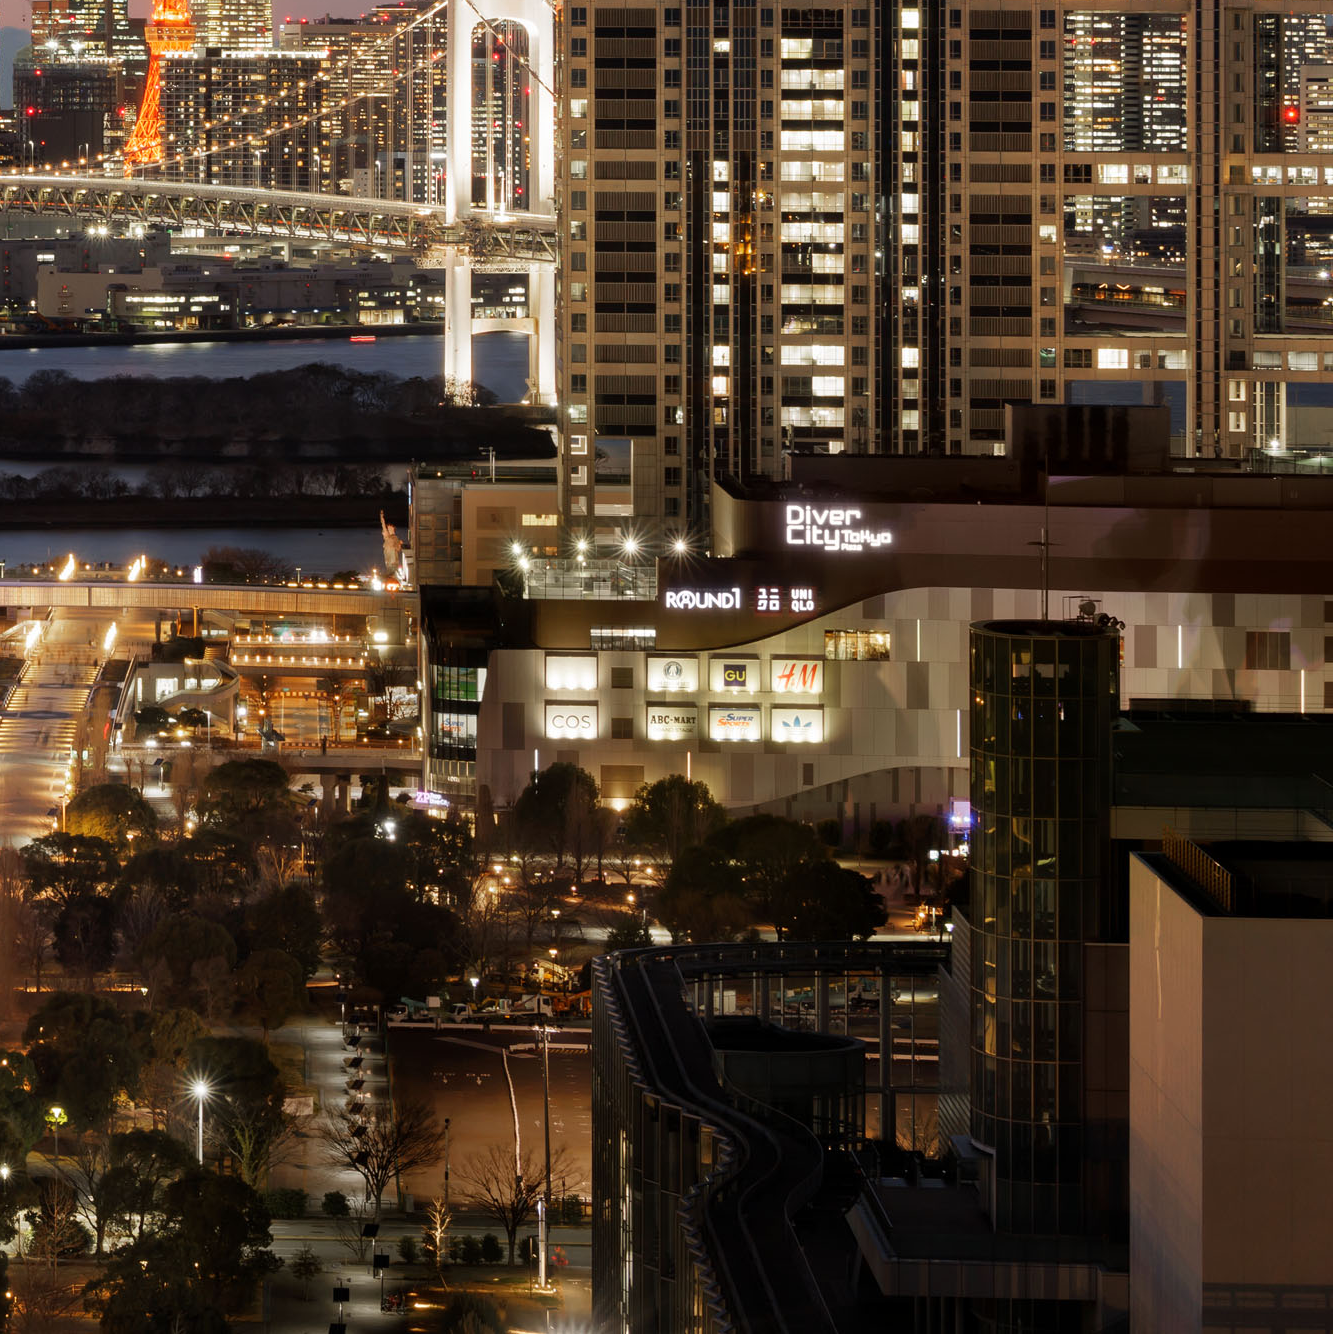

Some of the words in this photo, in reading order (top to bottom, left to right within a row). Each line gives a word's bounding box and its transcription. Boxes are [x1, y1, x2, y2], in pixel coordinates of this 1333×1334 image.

[786, 505, 862, 525] Diver
[786, 525, 841, 551] City
[665, 588, 741, 610] ROUND1
[791, 589, 813, 599] UNI
[791, 600, 815, 612] QLO
[724, 670, 747, 682] GU
[777, 663, 818, 690] H&M
[551, 714, 591, 729] COS
[650, 715, 696, 725] ABC-MART
